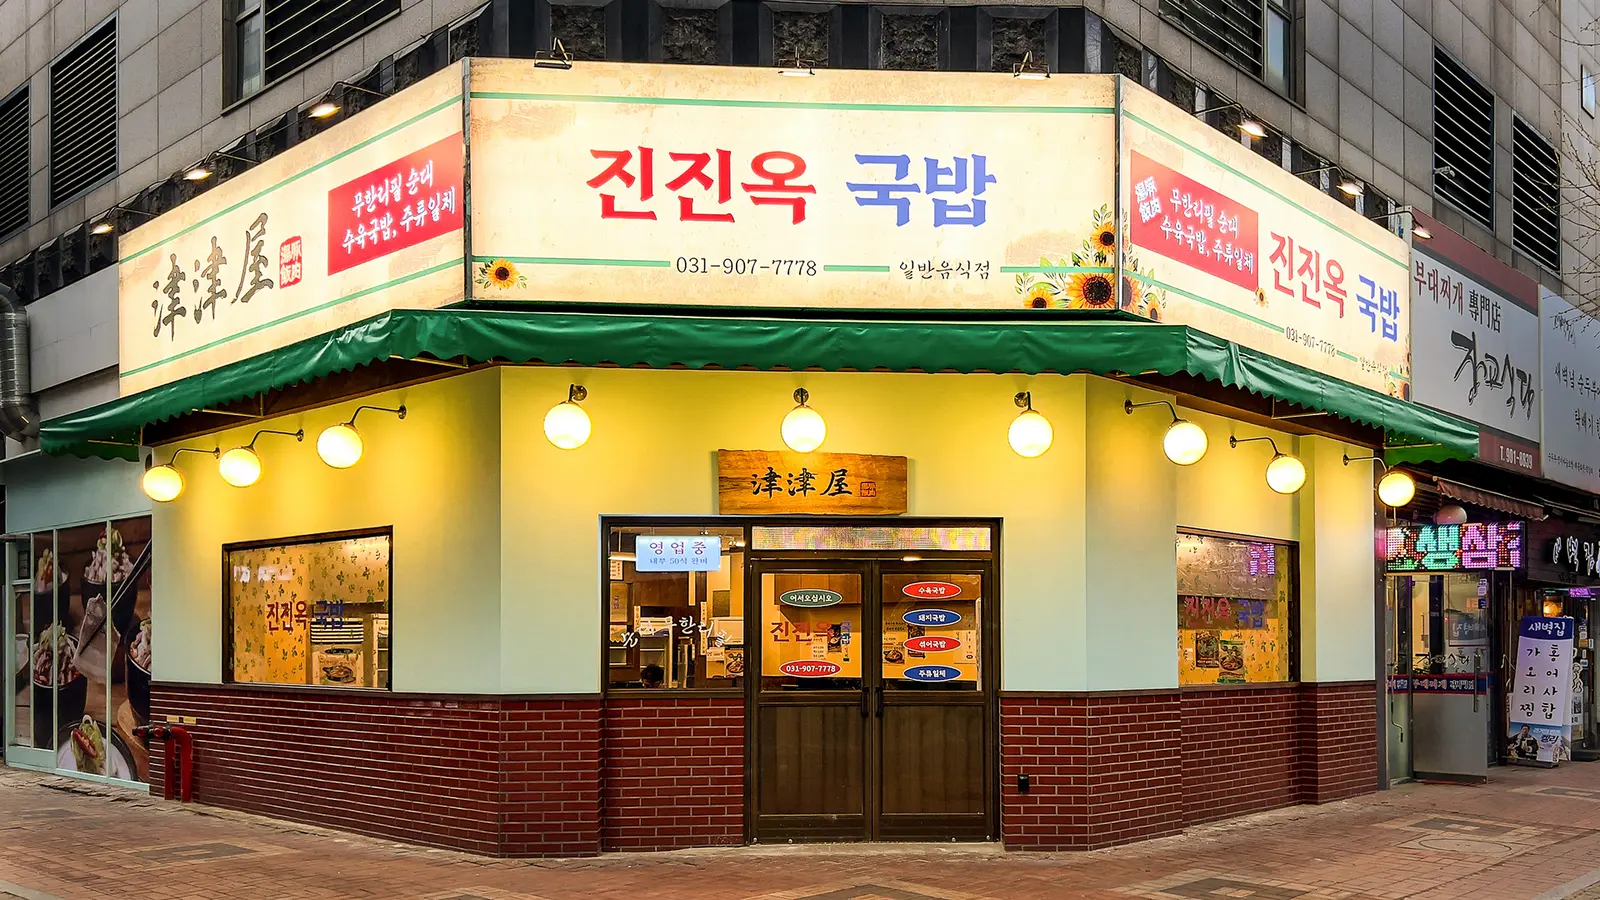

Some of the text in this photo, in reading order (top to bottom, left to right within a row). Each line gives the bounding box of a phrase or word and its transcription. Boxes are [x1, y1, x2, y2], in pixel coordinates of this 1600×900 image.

[352, 159, 433, 218] 무한리필 순대
[586, 145, 997, 228] 진진옥 국밥
[342, 186, 456, 254] 수육국밥, 주류일체
[1169, 188, 1238, 239] 무한리필 순대
[1160, 215, 1254, 275] 수육국밥, 주류일체
[152, 212, 273, 342] 津津屋
[676, 257, 817, 277] 031-907-7778
[898, 260, 991, 280] 일반음식점
[1269, 231, 1400, 342] 진진옥 국밥
[1414, 260, 1464, 315] 부대찌개
[751, 466, 853, 499] 津津屋
[789, 594, 832, 603] 어서오십시오
[918, 586, 946, 594] 수육국밥
[266, 601, 307, 632] 진진옥
[918, 613, 946, 622] 돼지국밥
[1528, 621, 1565, 637] 새벽집
[786, 665, 836, 673] 031-907-7778
[919, 669, 946, 678] 주류일체
